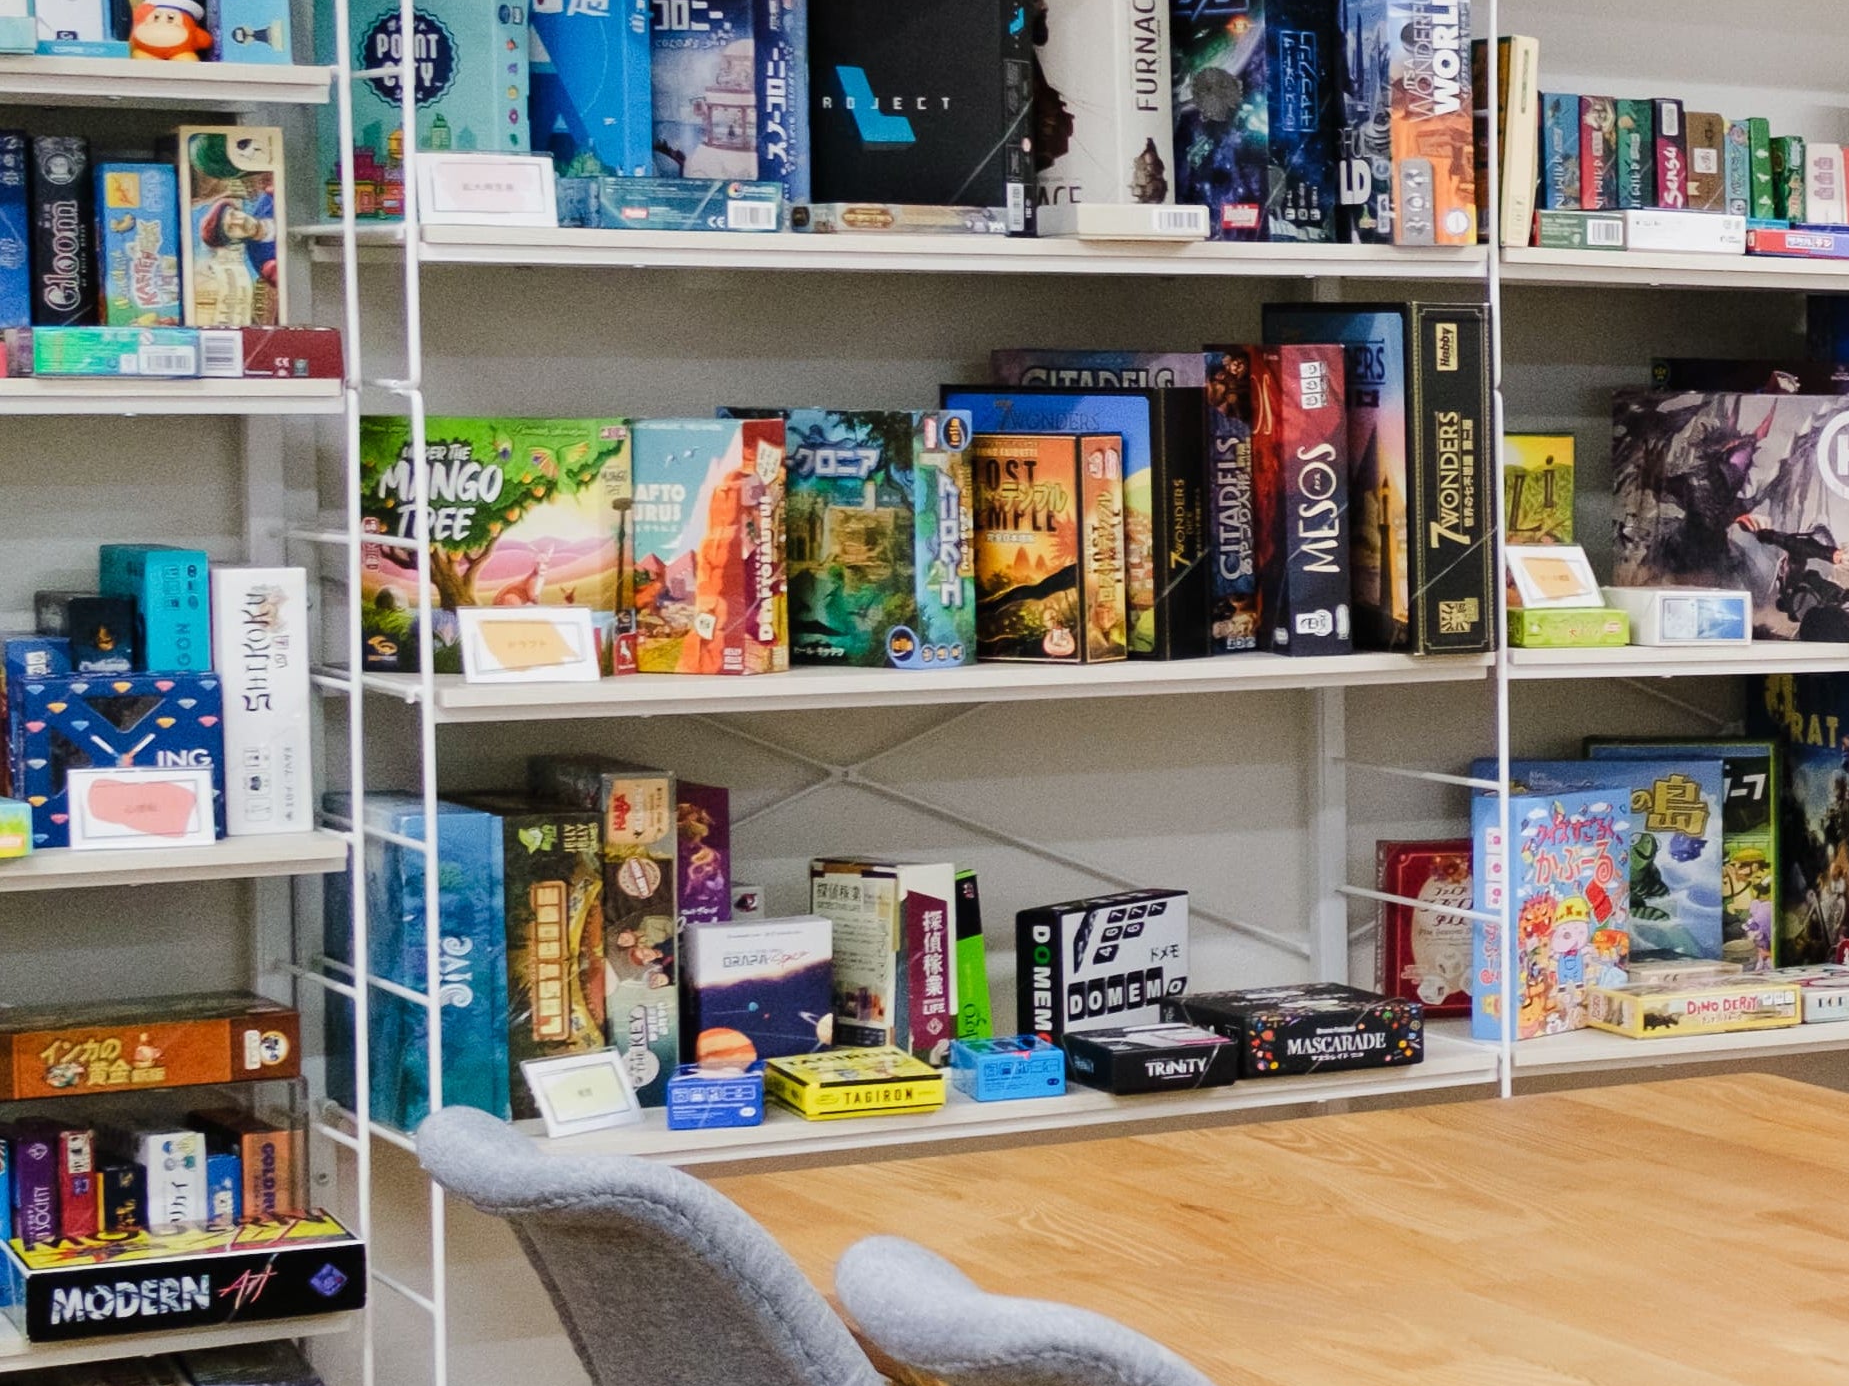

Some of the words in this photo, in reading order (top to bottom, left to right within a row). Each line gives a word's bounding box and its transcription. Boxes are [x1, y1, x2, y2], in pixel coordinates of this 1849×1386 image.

[44, 199, 82, 312] Gloom
[1438, 325, 1455, 370] Hobby
[448, 443, 471, 460] THE
[796, 447, 881, 478] クロニア
[1437, 411, 1460, 527] WONDERS
[1217, 436, 1240, 581] CITADELS
[1297, 442, 1341, 574] MESOS
[1463, 455, 1475, 527] 世界の七不思議
[1174, 478, 1185, 551] WONDERS
[938, 471, 962, 608] ユークロニア
[1430, 520, 1472, 550] 7
[758, 496, 774, 642] DRAFTOSAURUS
[243, 592, 272, 712] SHIKOKU
[1791, 713, 1839, 749] RAT
[613, 792, 630, 832] HABA
[1632, 774, 1710, 836] の島
[815, 881, 863, 902] 探偵稼業
[921, 909, 945, 997] 探偵稼業
[1149, 945, 1180, 963] ドメモ
[922, 1002, 947, 1015] LIFE
[1069, 975, 1184, 1015] DOMEMO
[39, 1037, 122, 1062] インカの
[628, 1012, 645, 1051] KEY
[1286, 1032, 1387, 1056] MASCARADE
[86, 1062, 132, 1086] 黄金
[844, 1087, 914, 1105] TAGIRON
[51, 1274, 211, 1325] MODERN
